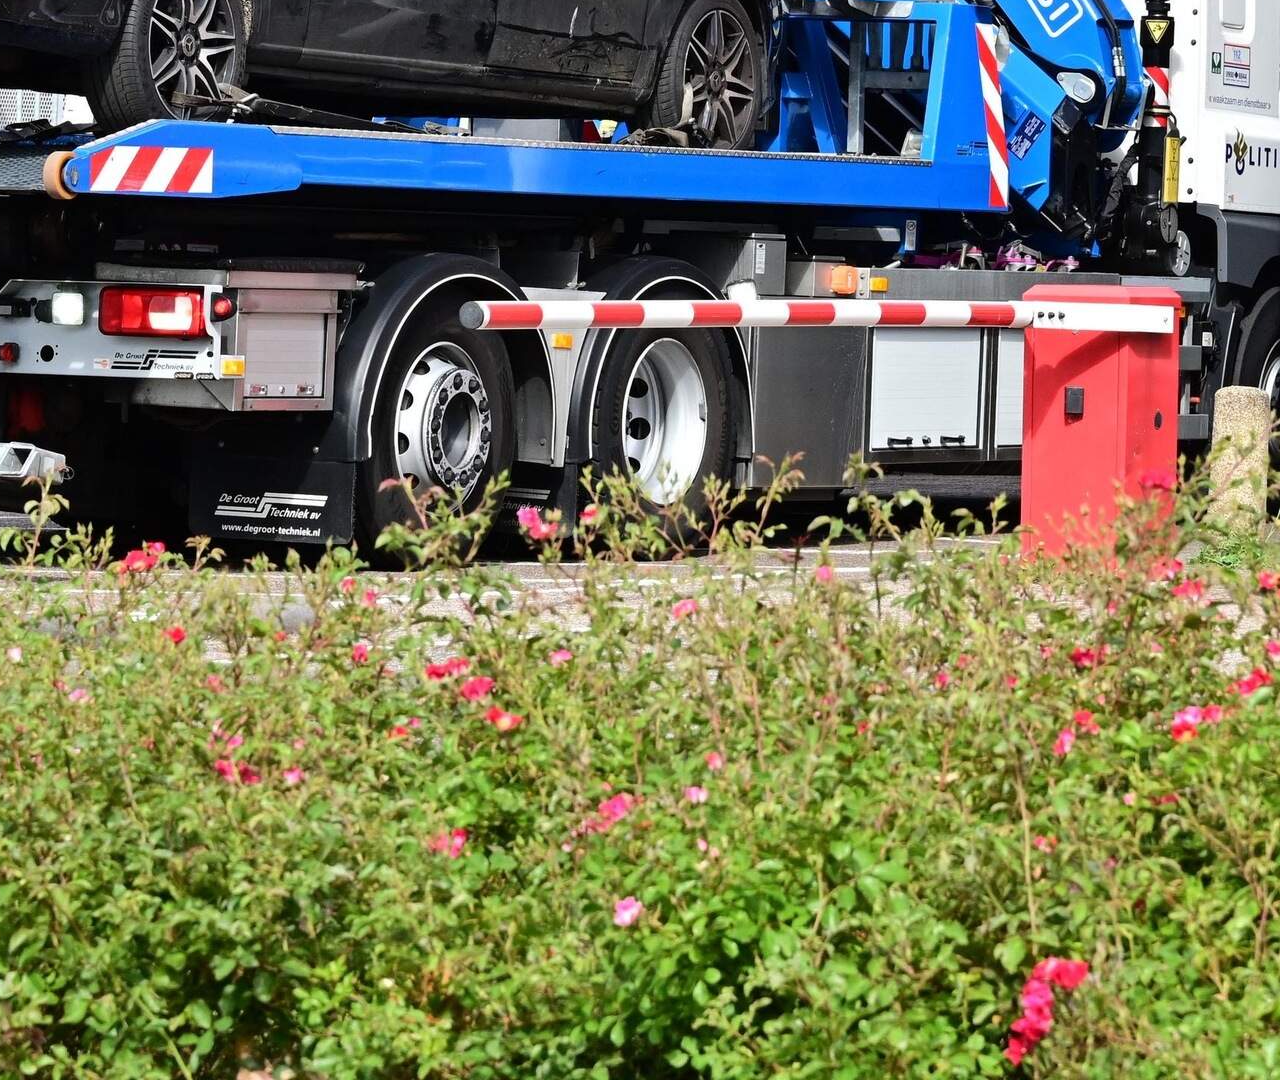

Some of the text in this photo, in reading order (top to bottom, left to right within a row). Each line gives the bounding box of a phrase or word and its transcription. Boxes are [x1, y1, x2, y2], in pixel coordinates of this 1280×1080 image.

[219, 493, 260, 504] De Groot
[269, 507, 322, 520] Techniek BV
[221, 523, 321, 537] www.degroot-techniek.nl
